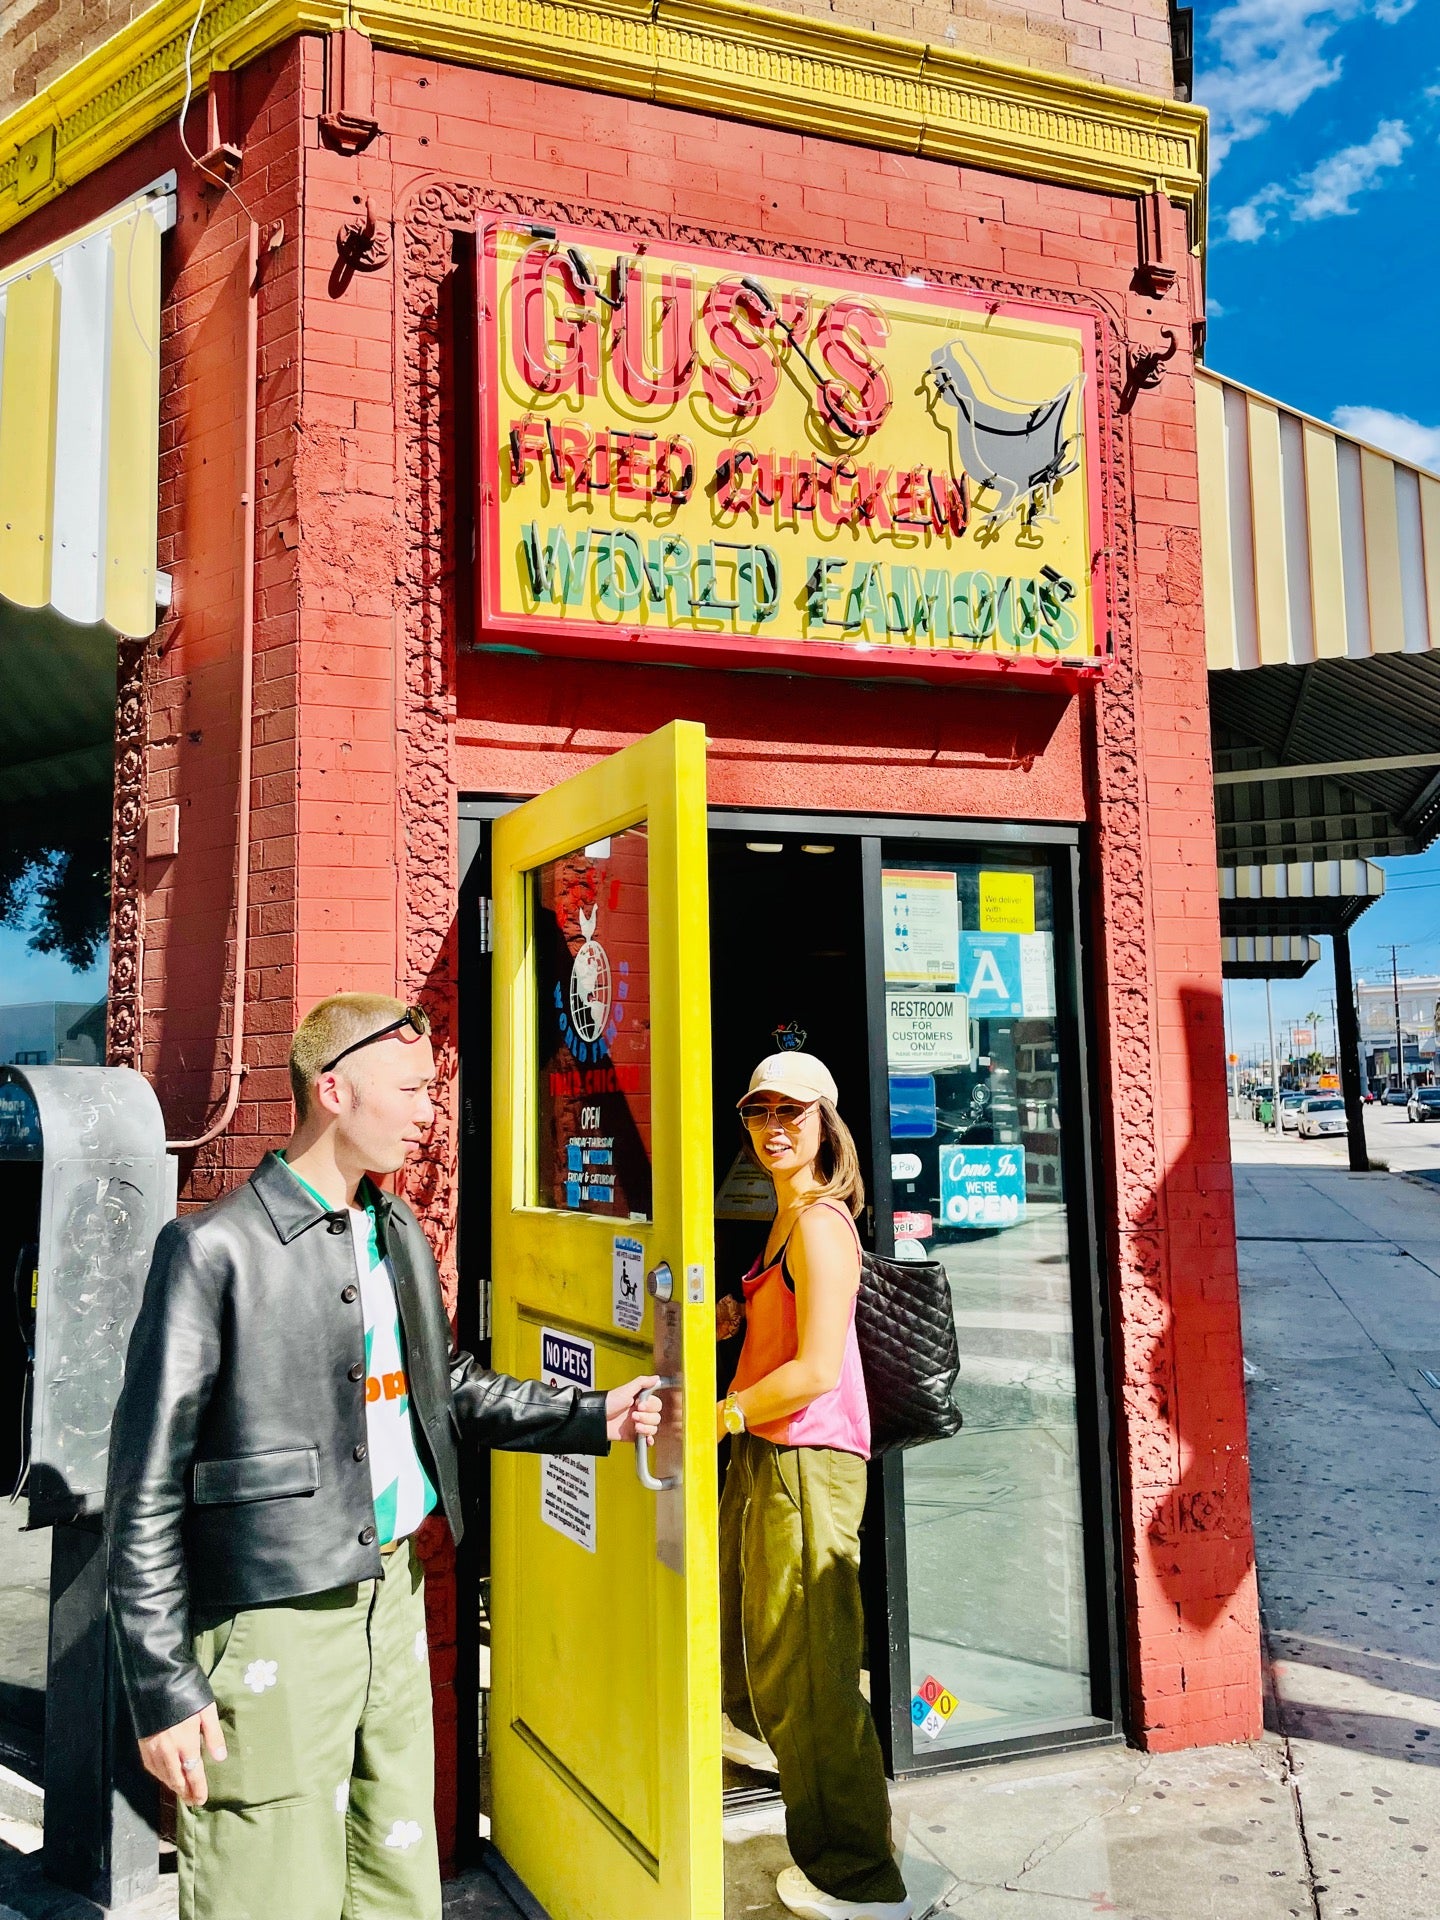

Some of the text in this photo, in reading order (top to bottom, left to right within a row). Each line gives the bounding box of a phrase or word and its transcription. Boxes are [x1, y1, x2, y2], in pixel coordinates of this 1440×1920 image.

[511, 239, 892, 438] GUS'S
[509, 413, 971, 538] FRIED CHICKEN
[521, 522, 1079, 648] WORLD FAMOUS
[968, 950, 1010, 998] A
[891, 1001, 953, 1017] RESTROOM
[892, 1031, 953, 1041] CUSTOMERS
[912, 1021, 932, 1030] FOR
[910, 1042, 936, 1051] ONLY
[581, 1106, 601, 1130] OPEN
[899, 1161, 915, 1173] Pay
[949, 1153, 1018, 1181] Come In
[965, 1181, 998, 1193] WE'RE
[946, 1194, 1018, 1222] OPEN
[546, 1340, 588, 1379] NO PETS
[925, 1681, 936, 1701] 0
[912, 1695, 951, 1720] 3 0
[926, 1715, 939, 1732] SA
